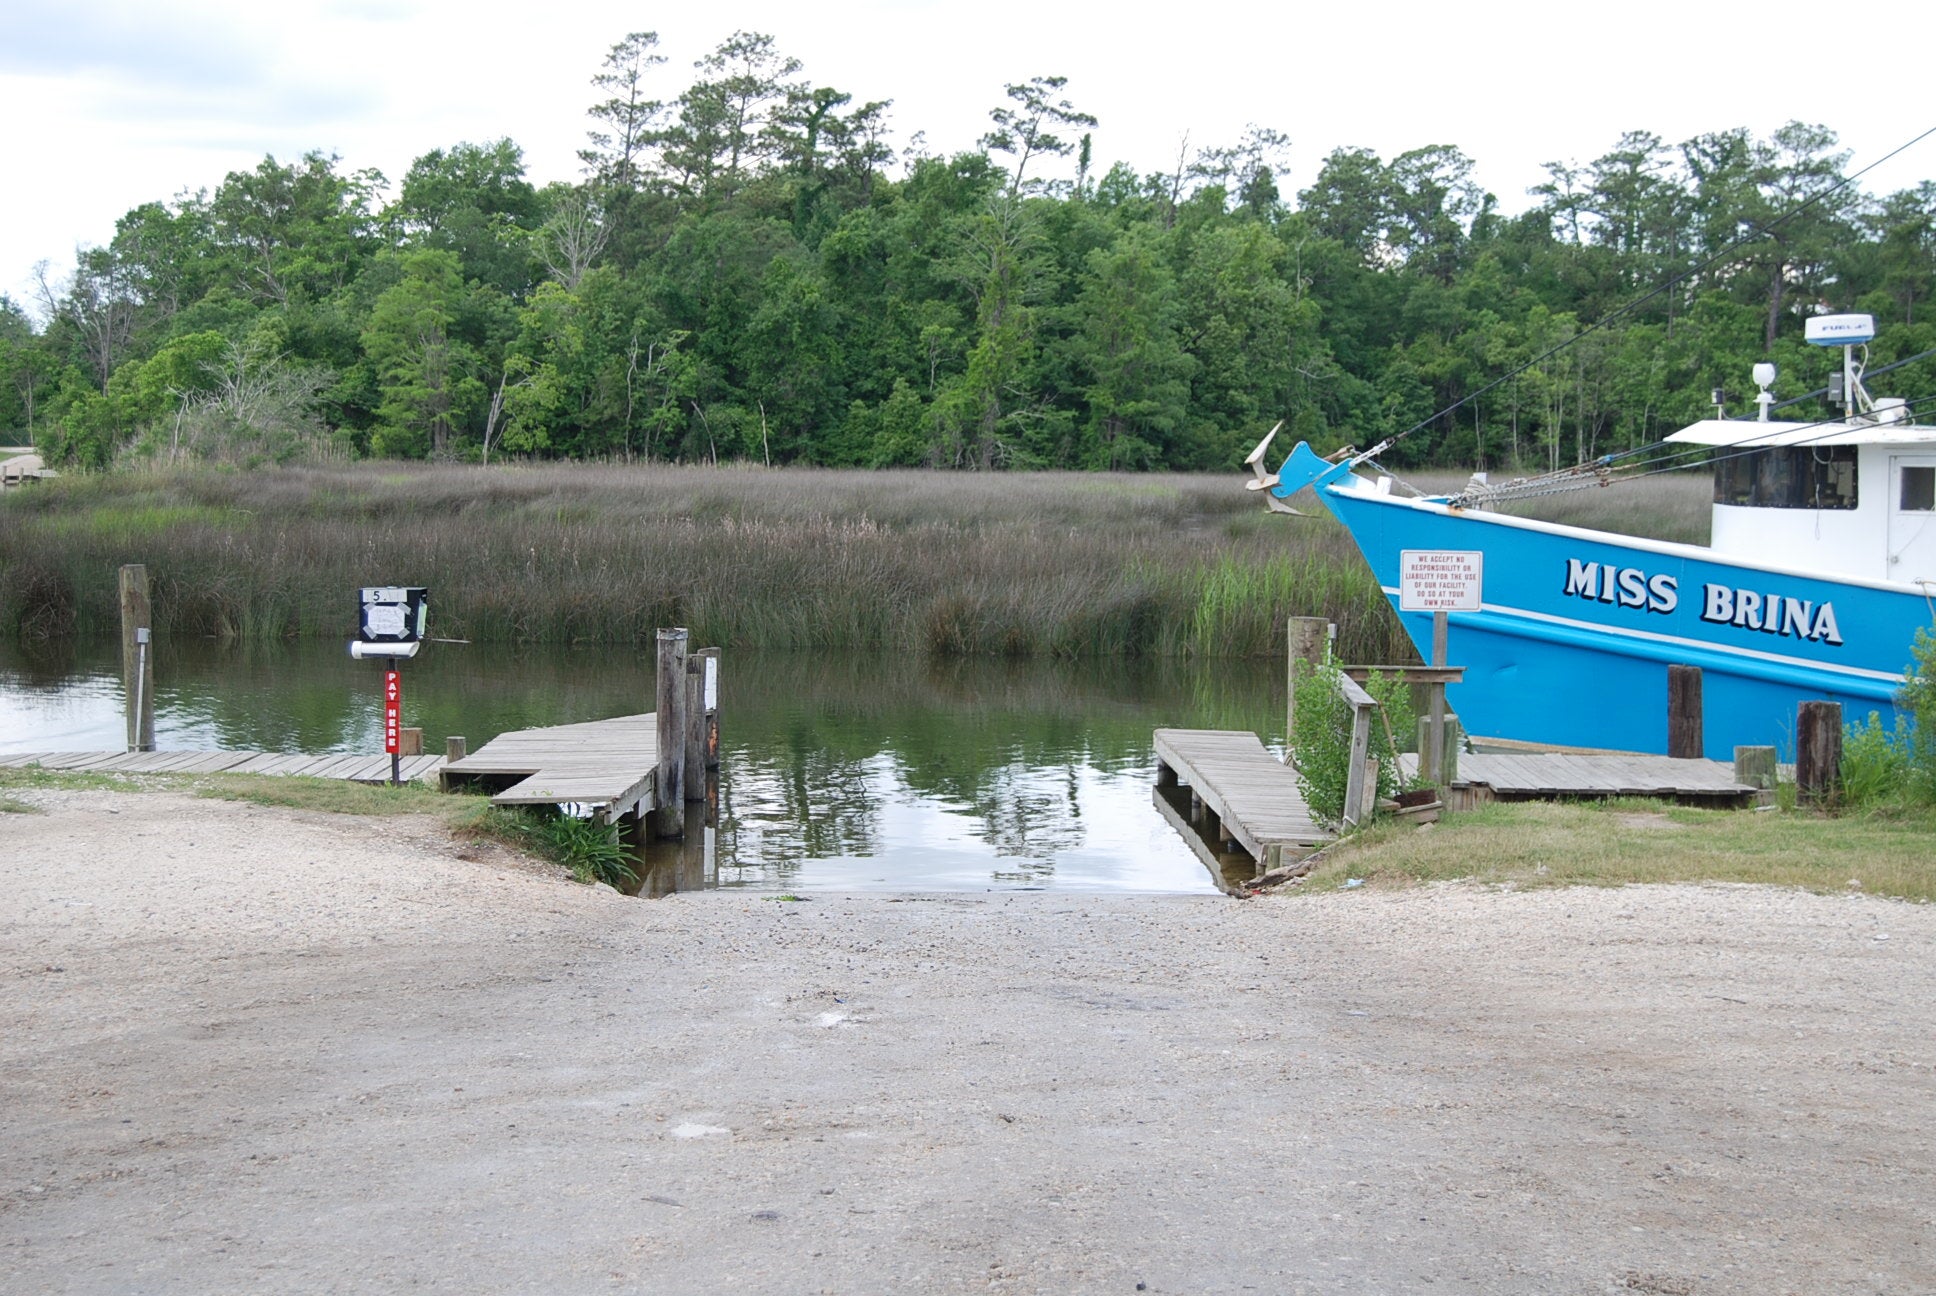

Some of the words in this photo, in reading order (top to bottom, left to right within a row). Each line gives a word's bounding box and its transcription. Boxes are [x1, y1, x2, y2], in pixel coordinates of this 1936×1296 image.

[1564, 558, 1678, 614] MISS
[1701, 583, 1843, 646] BRINA
[388, 672, 396, 700] PAY
[388, 709, 396, 746] HERE
